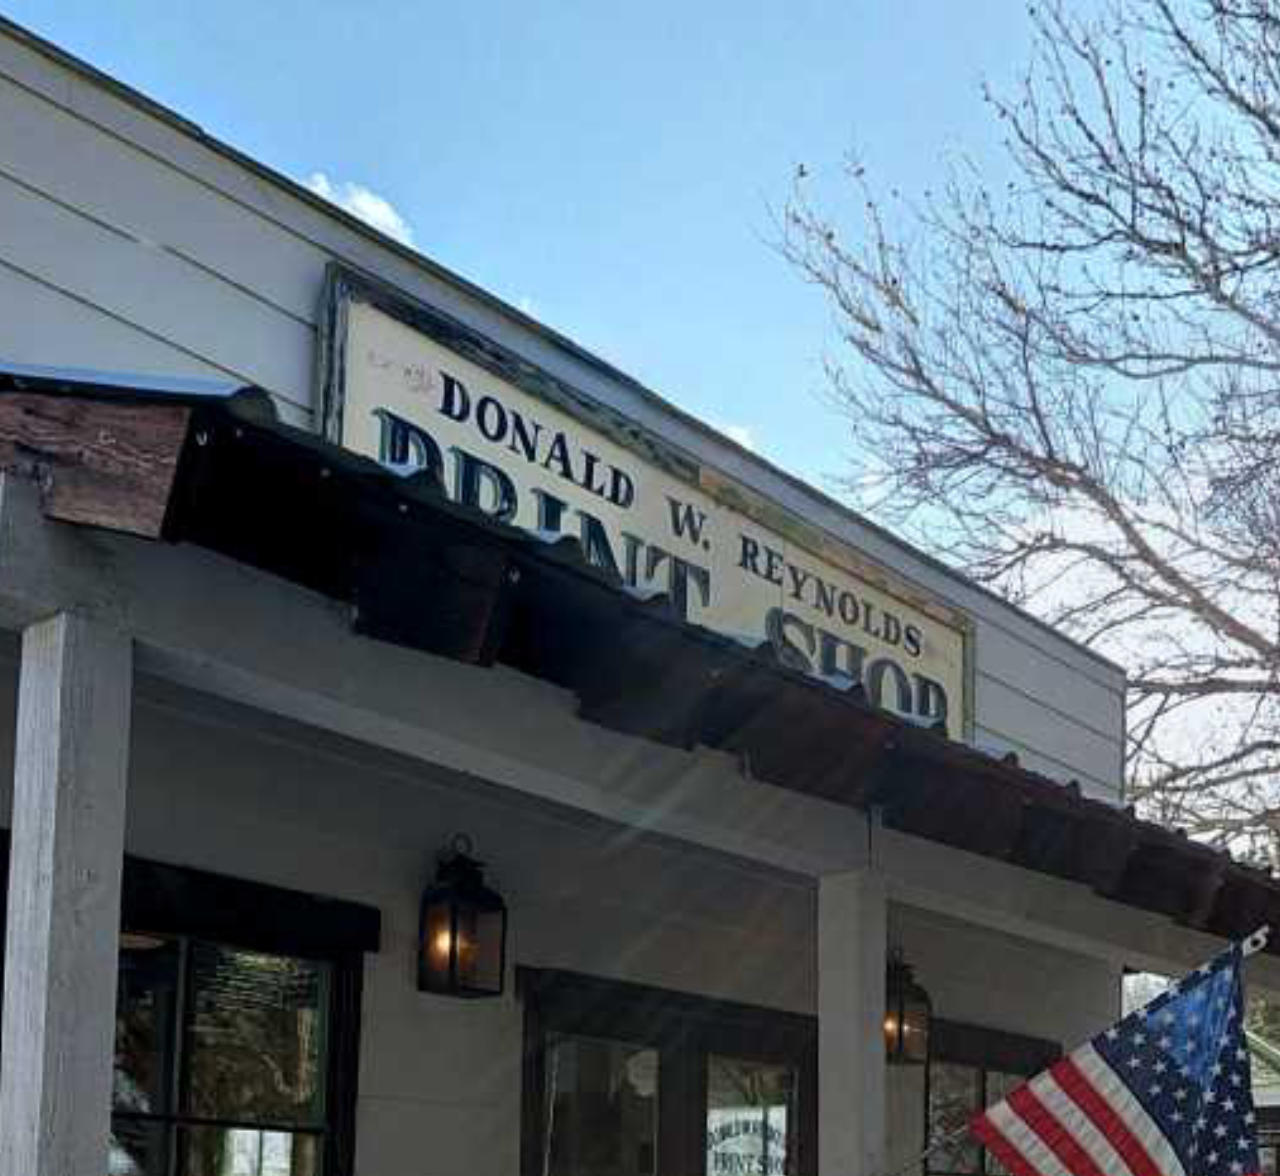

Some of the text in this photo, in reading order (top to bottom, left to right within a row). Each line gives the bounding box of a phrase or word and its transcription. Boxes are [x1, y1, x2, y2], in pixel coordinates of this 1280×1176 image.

[439, 370, 923, 658] DONALD W. REYNOLDS
